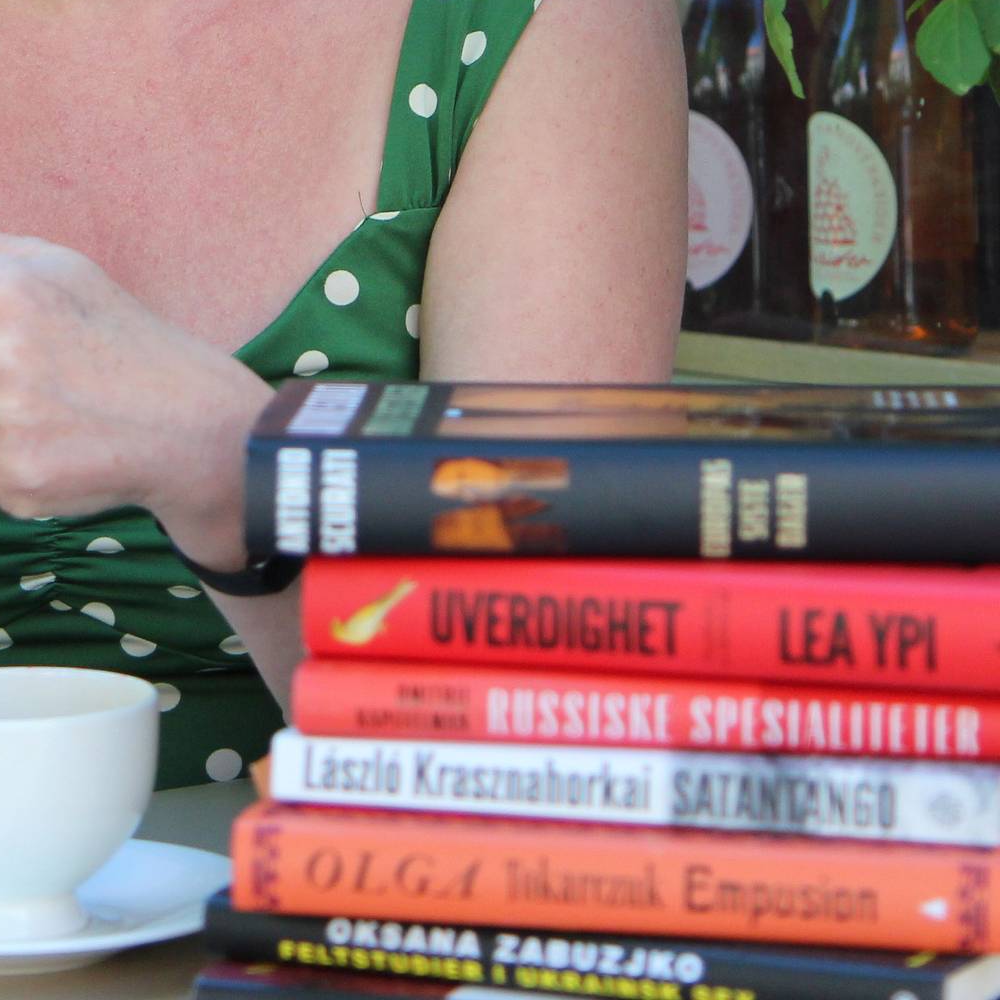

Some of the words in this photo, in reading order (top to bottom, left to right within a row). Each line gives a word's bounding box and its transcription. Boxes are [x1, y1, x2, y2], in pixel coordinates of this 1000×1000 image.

[320, 448, 358, 555] SCURATI
[429, 589, 685, 657] UVERDIGHET
[778, 606, 856, 668] LEA
[868, 611, 938, 673] YPI
[486, 687, 673, 742] RUSSISKE
[690, 696, 981, 756] SPESIALITETER
[304, 743, 401, 794] László
[413, 750, 652, 809] Krasznahorkai
[672, 768, 898, 830] SATANTANGO
[304, 848, 484, 900] OLGA
[683, 864, 880, 924] Empusion
[277, 939, 484, 982] FELTSTUDIER
[491, 962, 506, 984] I
[514, 965, 682, 1000] UKRAINSK
[325, 917, 481, 959] OKSANA
[492, 933, 706, 984] ZABUZJKO
